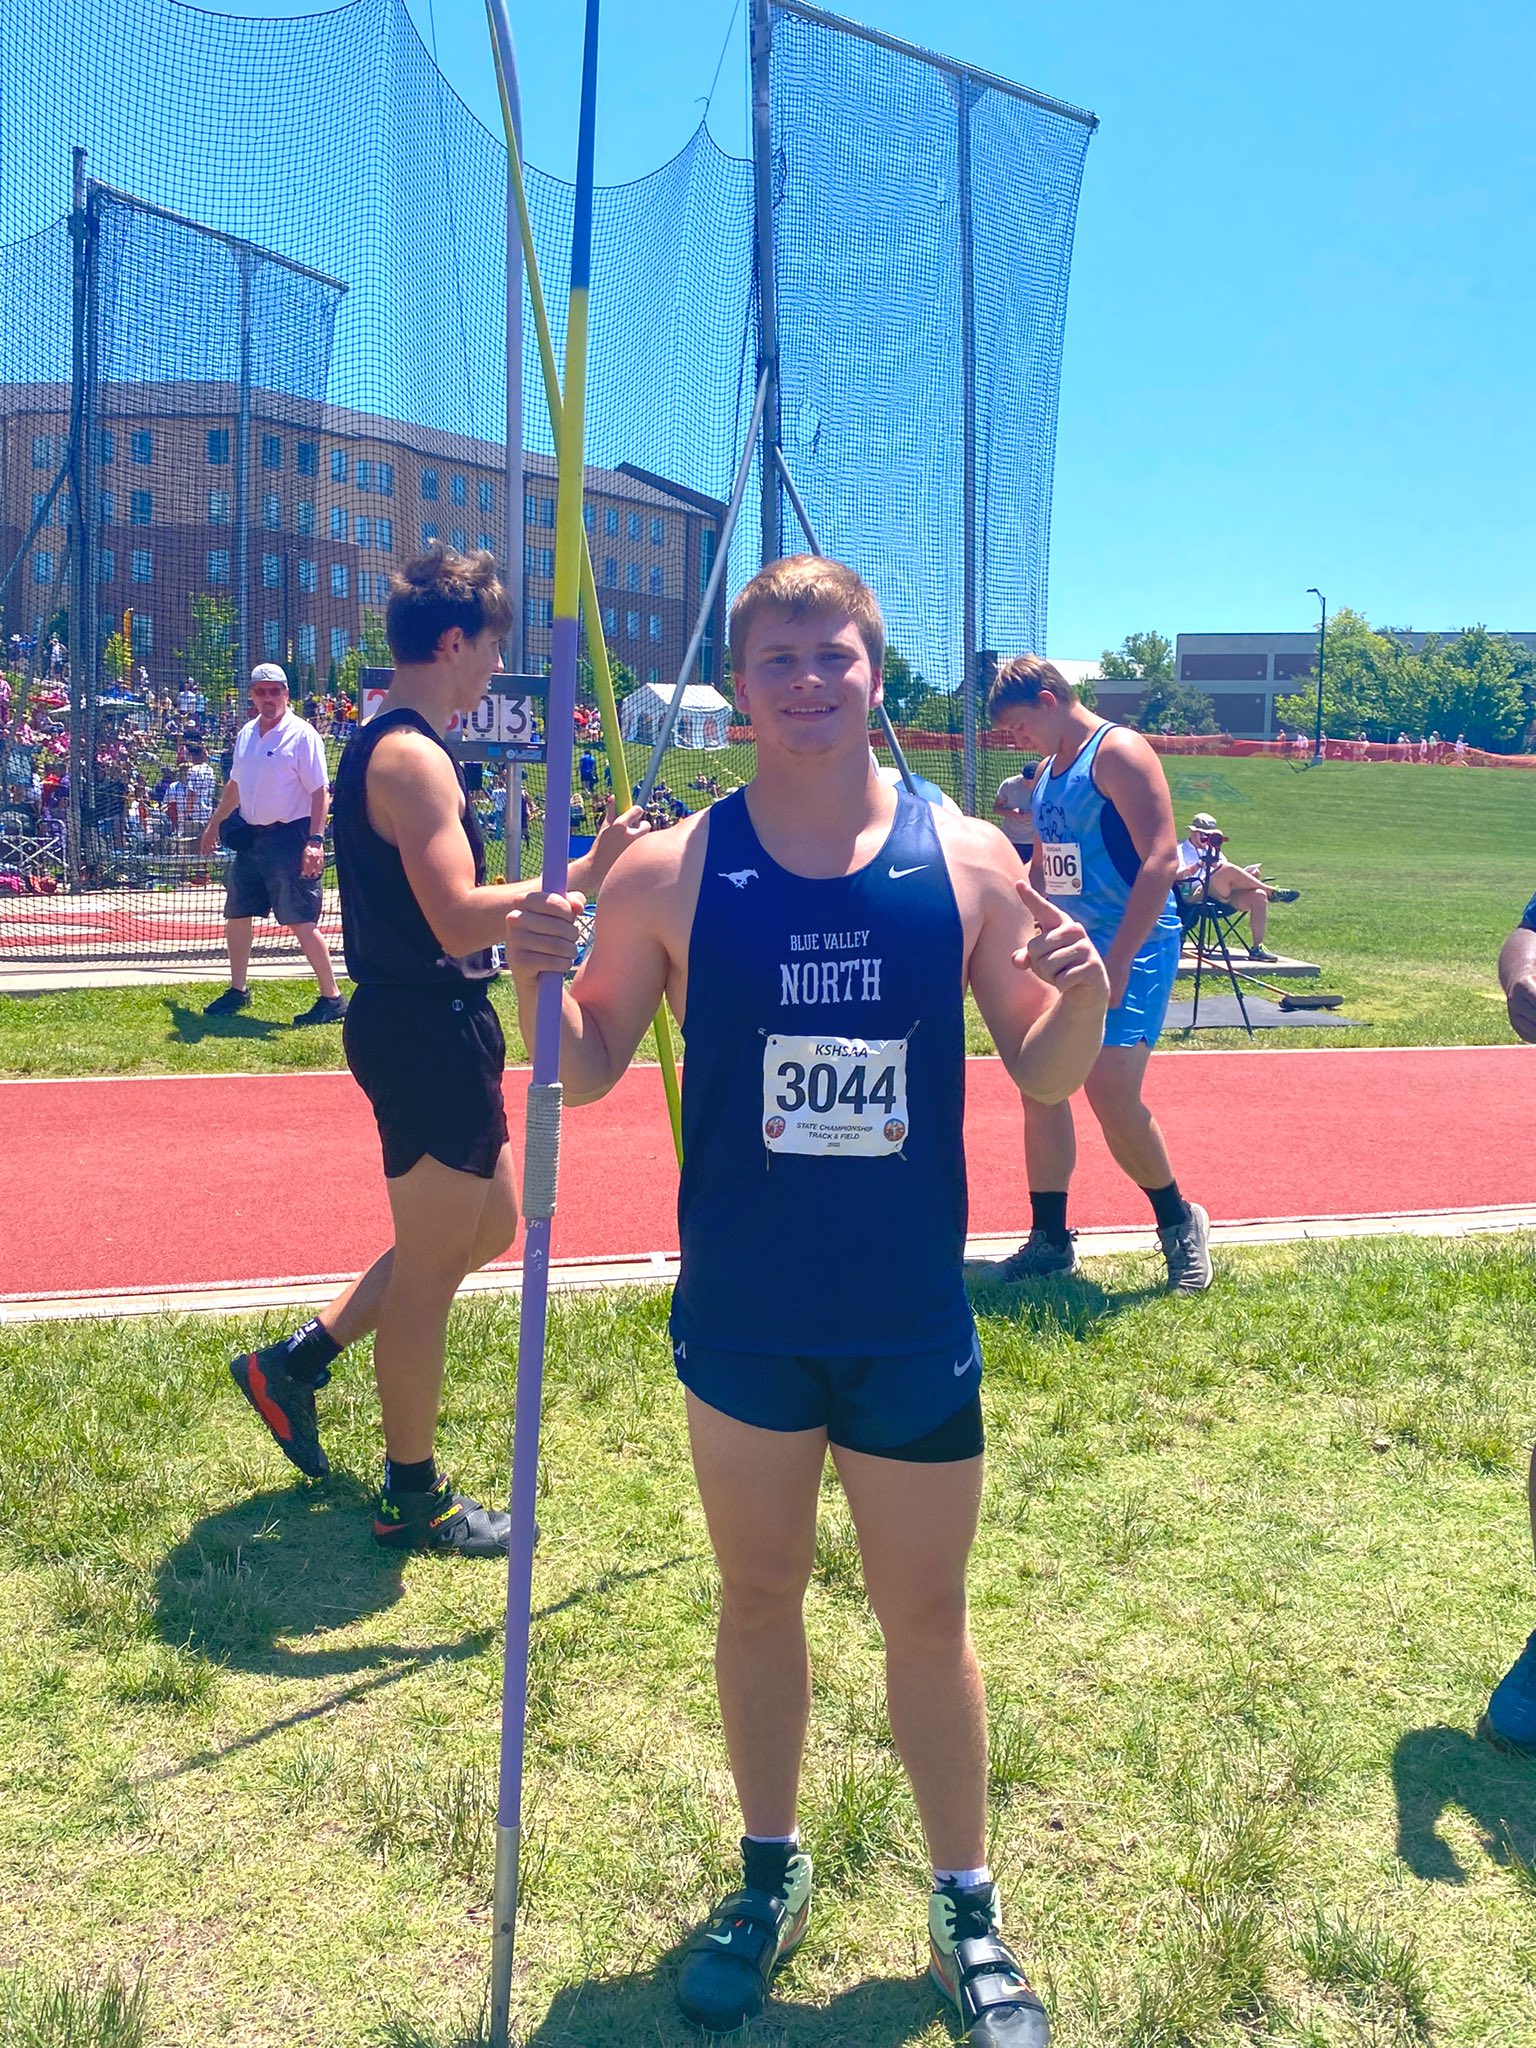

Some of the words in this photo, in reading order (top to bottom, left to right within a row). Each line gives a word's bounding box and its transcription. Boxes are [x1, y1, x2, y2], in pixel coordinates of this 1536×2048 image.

[790, 933, 820, 951] BLUE
[822, 930, 870, 949] VALLEY
[780, 958, 882, 1006] NORTH
[815, 1044, 868, 1058] KSHSAA
[776, 1061, 897, 1115] 3044
[796, 1122, 818, 1130] STATE
[819, 1124, 873, 1132] CHAMPIONSHIP
[808, 1131, 832, 1139] TRACK
